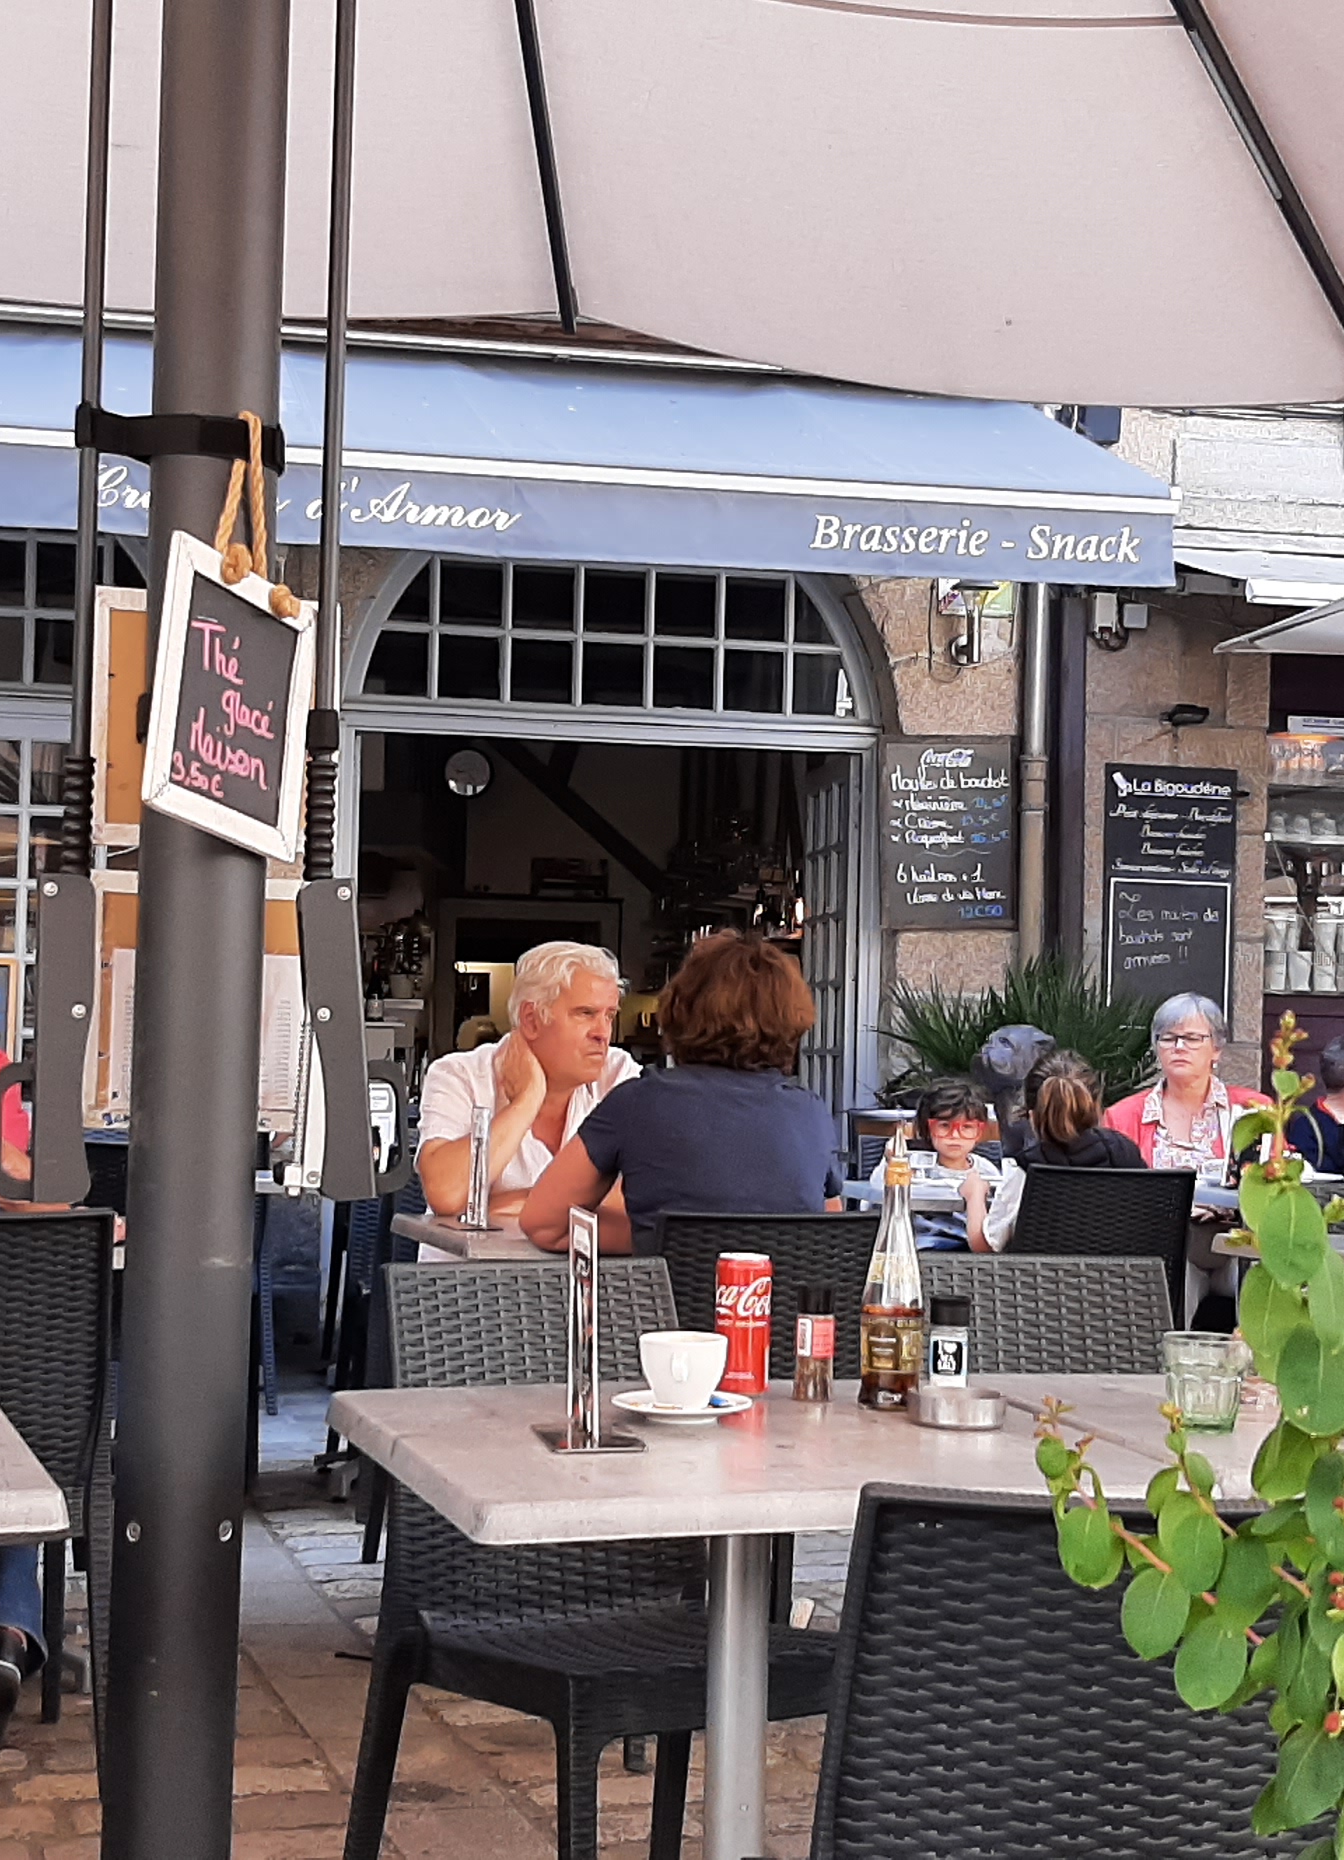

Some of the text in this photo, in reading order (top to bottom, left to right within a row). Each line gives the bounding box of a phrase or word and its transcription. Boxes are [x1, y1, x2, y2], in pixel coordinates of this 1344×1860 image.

[809, 513, 990, 557] Brasserie
[1026, 524, 1142, 564] Snack
[190, 619, 245, 686] Thé
[221, 689, 275, 741] glacé
[1133, 778, 1151, 792] La
[897, 863, 907, 883] 6
